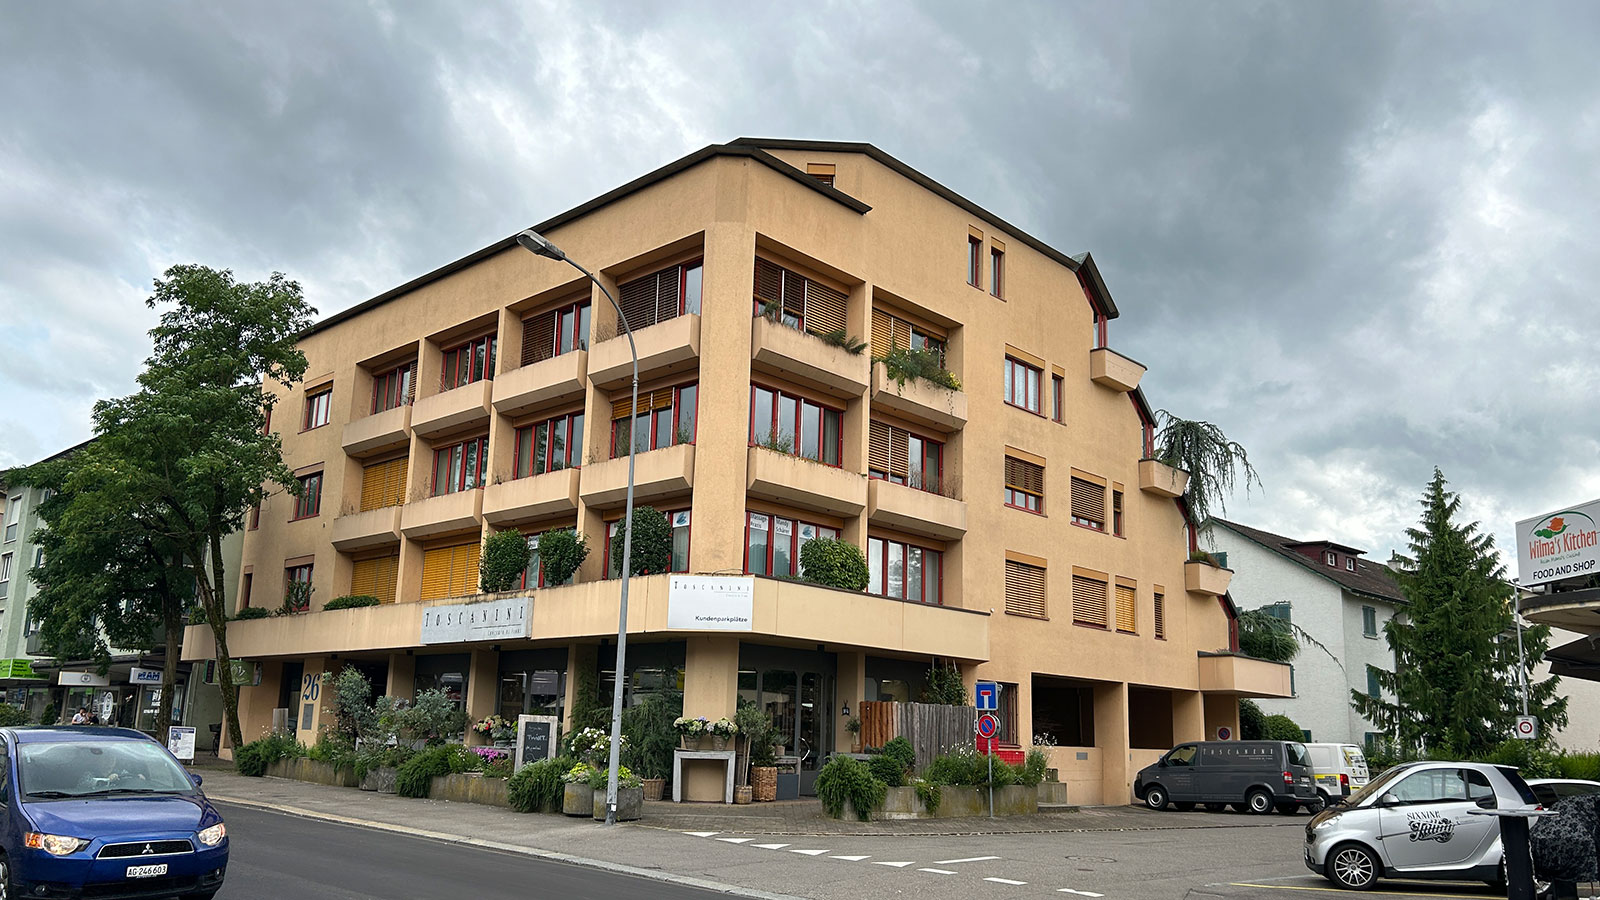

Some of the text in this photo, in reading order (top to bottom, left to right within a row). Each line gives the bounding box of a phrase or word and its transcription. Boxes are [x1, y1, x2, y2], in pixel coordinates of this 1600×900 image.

[1529, 529, 1597, 559] Wilma's Kitchen
[1532, 559, 1596, 580] FOOD AND SHOP
[673, 581, 750, 592] TOSCANINI
[426, 606, 523, 627] TOSCANINI
[694, 615, 748, 624] Kundenparkplätze
[302, 673, 320, 701] 26
[1202, 748, 1273, 756] TOSCANINI
[139, 866, 166, 875] 246603
